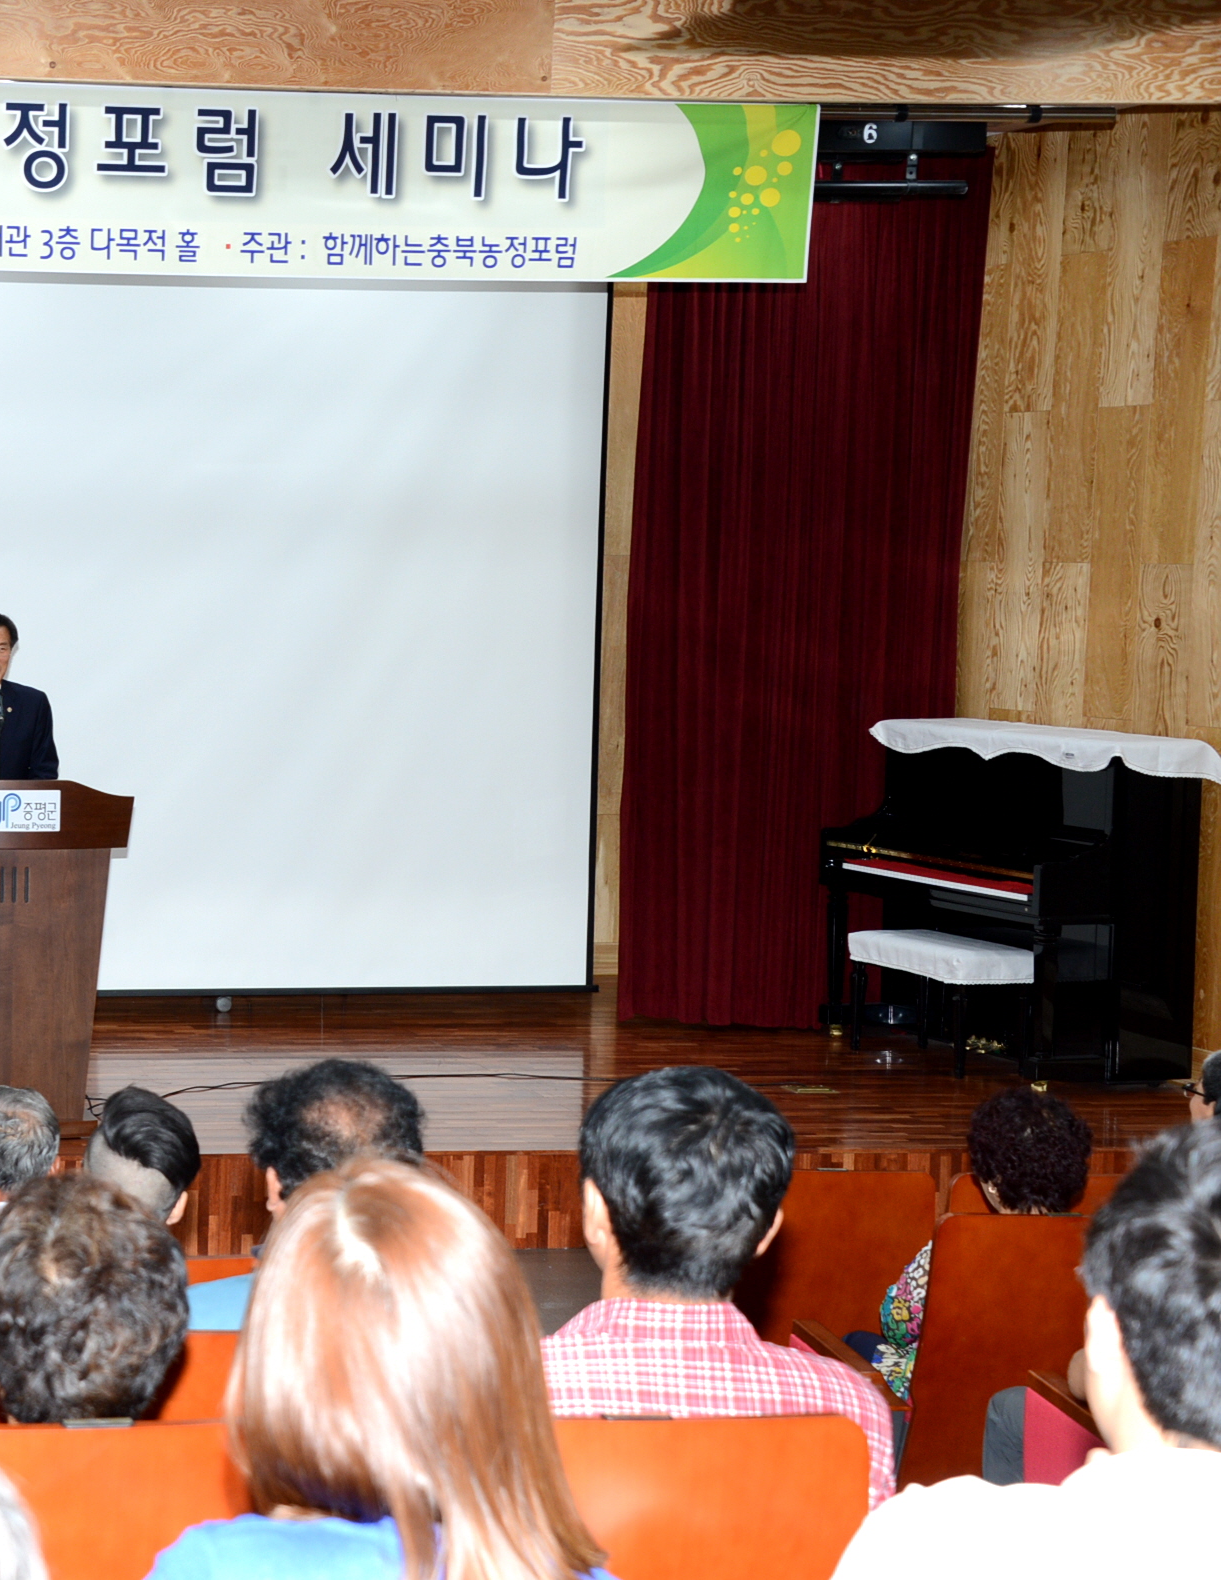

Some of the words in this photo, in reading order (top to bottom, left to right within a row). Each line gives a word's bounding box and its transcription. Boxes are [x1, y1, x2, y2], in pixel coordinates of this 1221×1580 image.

[863, 123, 878, 144] 6
[329, 112, 584, 200] 세미나
[40, 226, 81, 261] 3층
[90, 228, 166, 261] 다목적
[176, 229, 200, 263] 홀
[323, 232, 578, 269] 함께하는충북농정포럼
[10, 822, 30, 830] Jeung
[32, 822, 56, 830] Pyeong
[23, 802, 57, 821] 증평군
